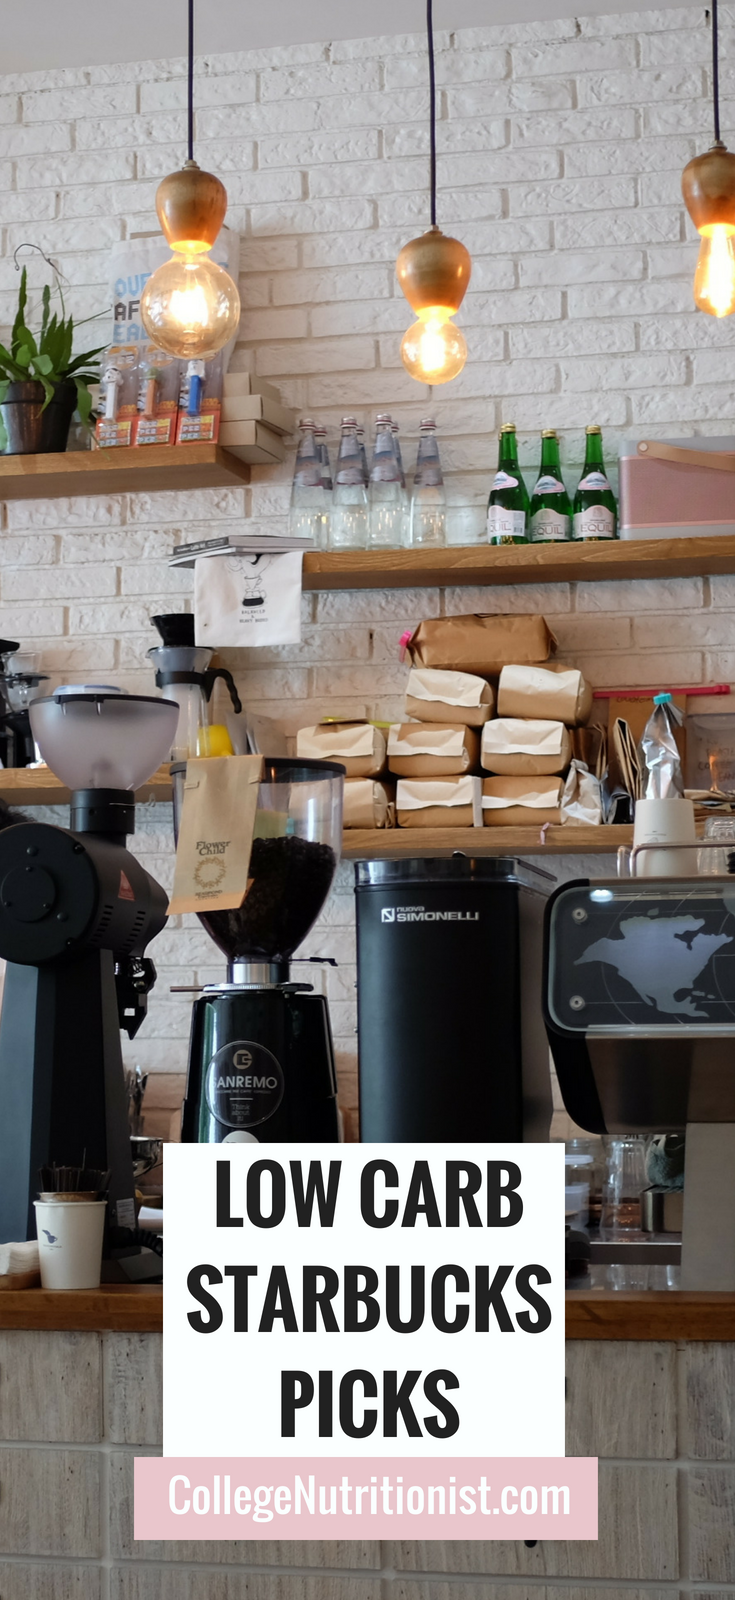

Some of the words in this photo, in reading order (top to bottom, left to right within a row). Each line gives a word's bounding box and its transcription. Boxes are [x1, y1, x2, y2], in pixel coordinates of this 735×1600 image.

[195, 841, 231, 850] Flower
[198, 846, 226, 856] Child
[396, 911, 480, 922] SIMONELLI
